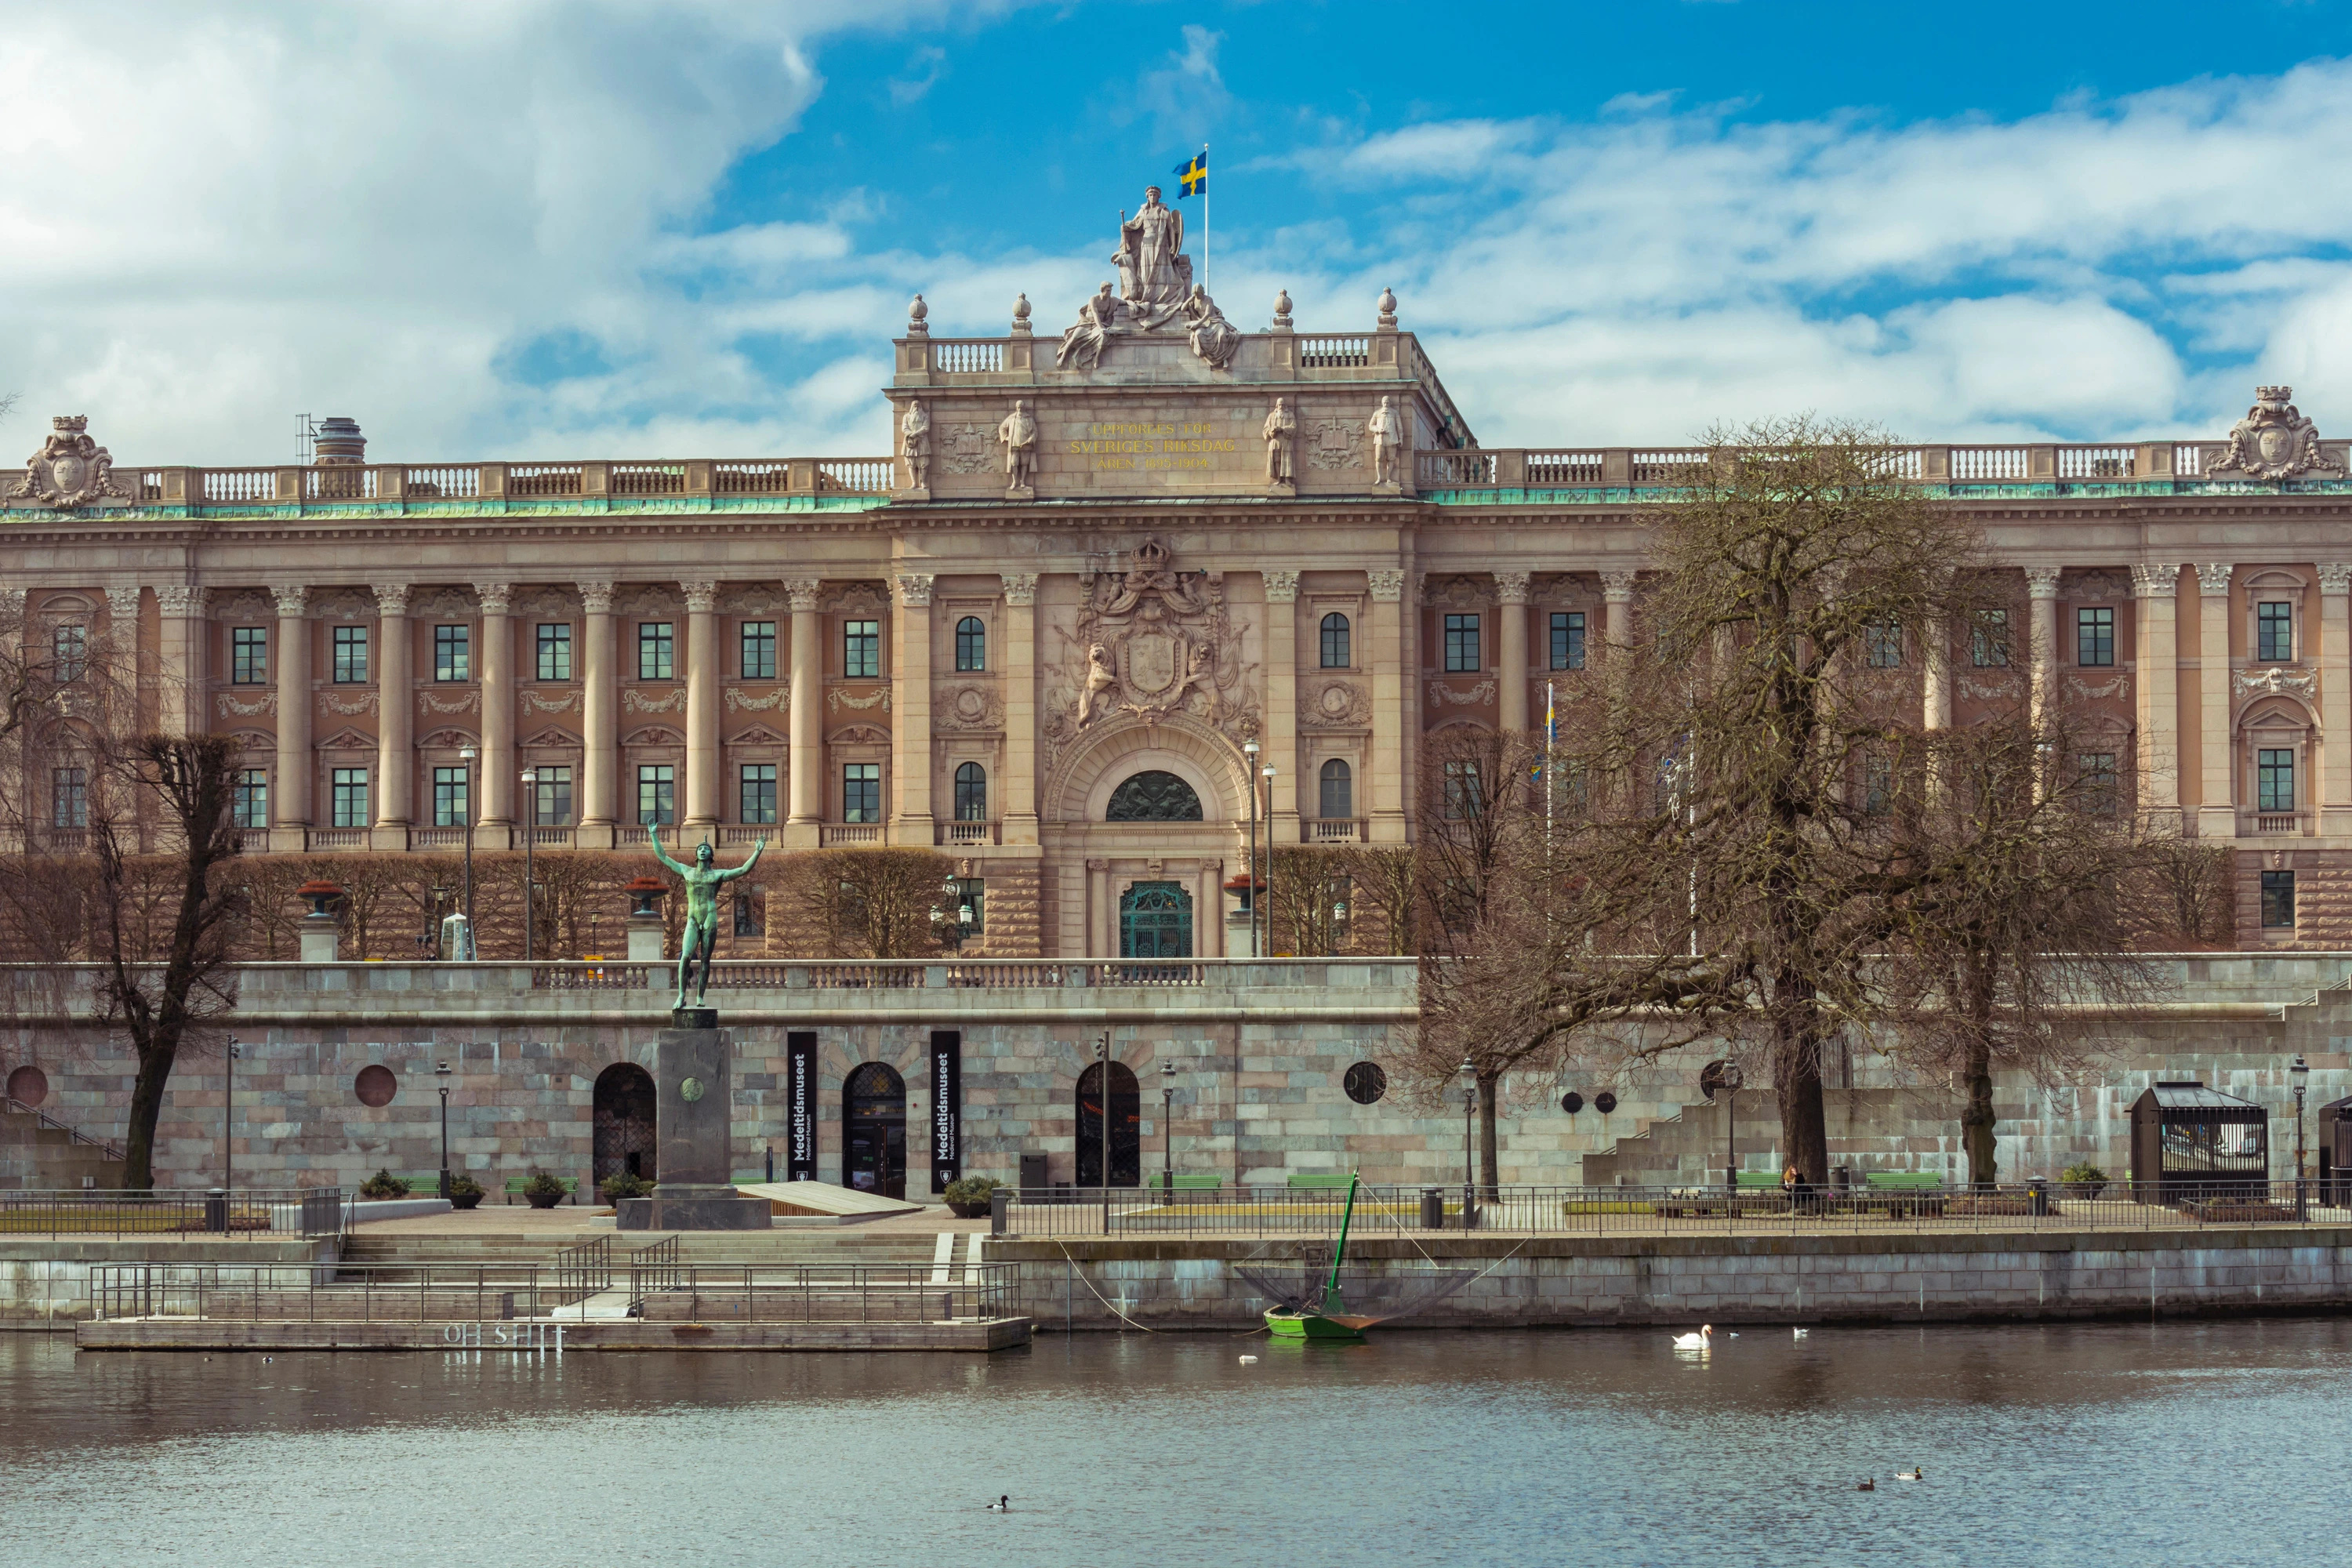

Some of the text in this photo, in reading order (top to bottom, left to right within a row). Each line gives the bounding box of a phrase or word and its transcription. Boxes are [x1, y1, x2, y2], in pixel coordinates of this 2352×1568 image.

[1093, 423, 1212, 434] UPPFÖRDES FÖR
[1071, 439, 1235, 453] SVERIGES RIKSDAG
[1097, 456, 1208, 469] ÅREN 1895-1904
[793, 1054, 804, 1160] Medeltidsmuseet
[937, 1053, 948, 1160] Medeltidsmuseet
[445, 1323, 481, 1347] OH
